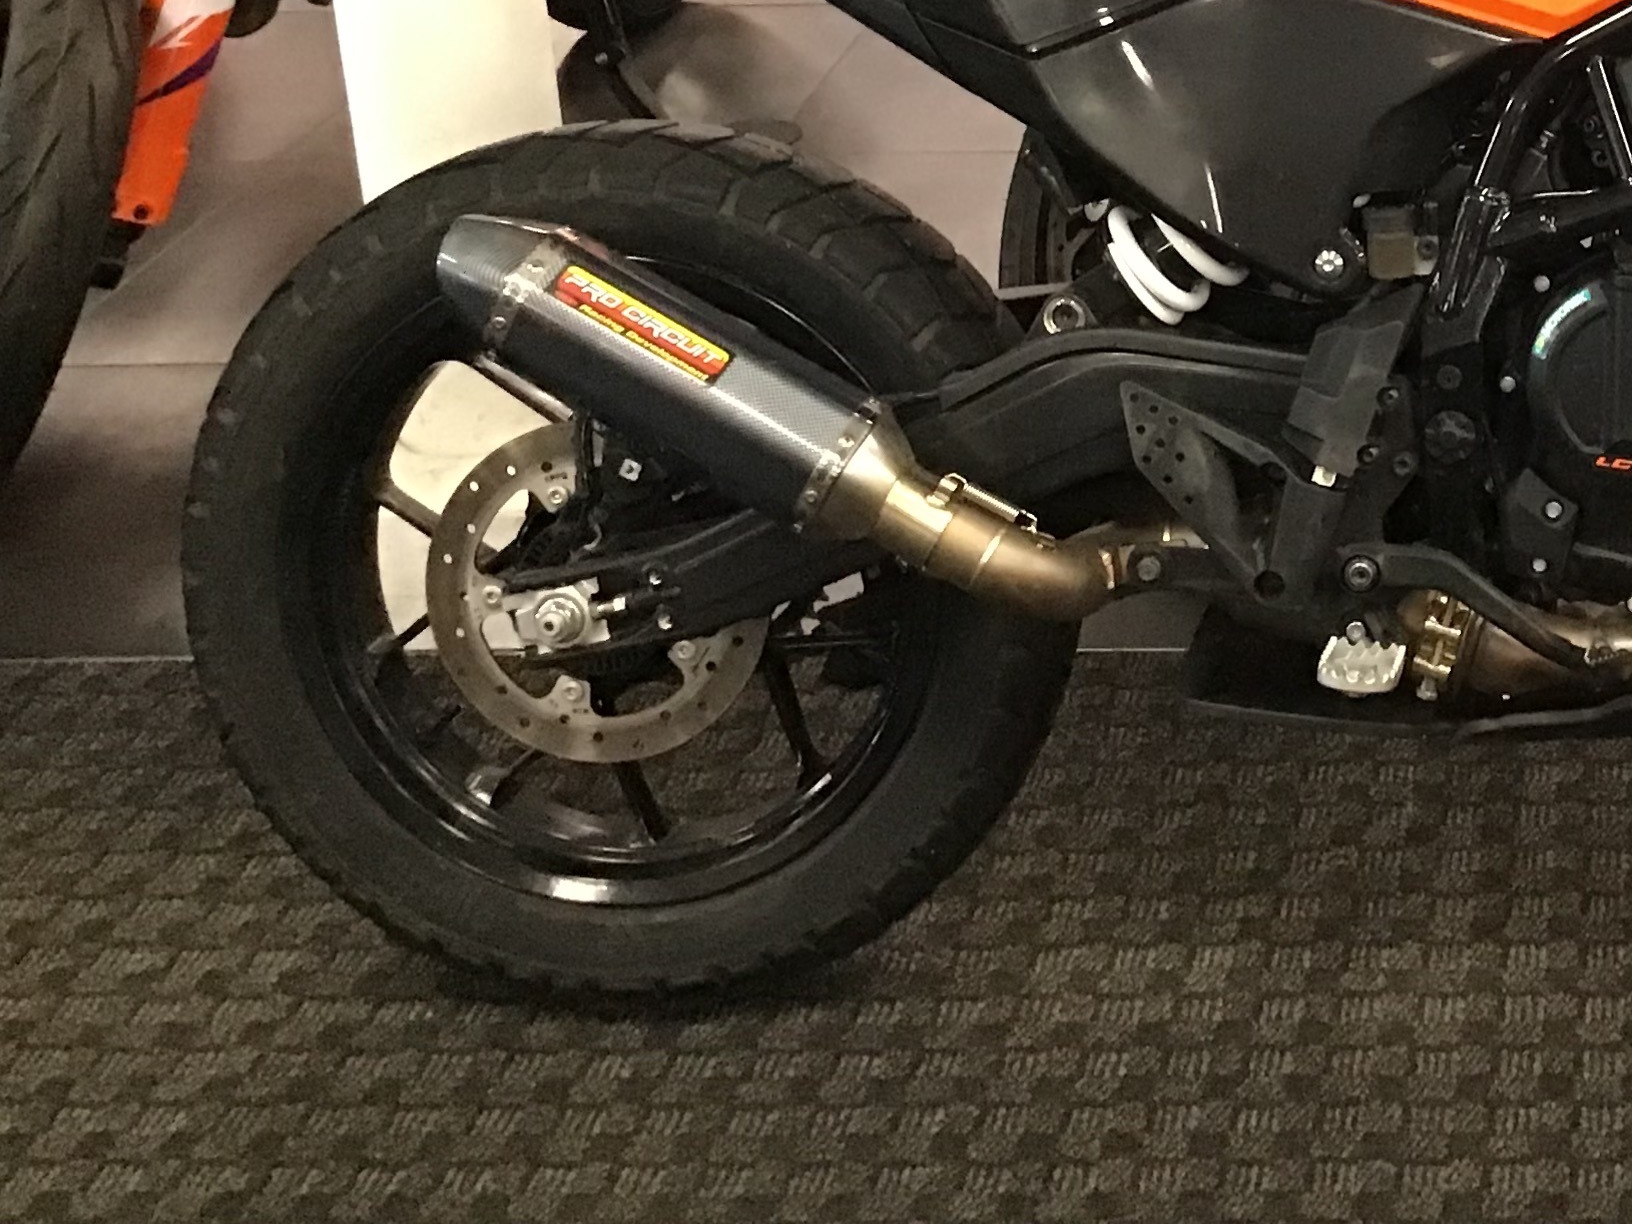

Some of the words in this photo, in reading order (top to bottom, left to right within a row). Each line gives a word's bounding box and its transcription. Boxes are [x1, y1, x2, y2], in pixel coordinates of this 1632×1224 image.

[564, 273, 623, 309] PRO
[620, 305, 723, 364] CIRCUIT
[578, 304, 626, 334] Racing
[625, 330, 710, 381] Development
